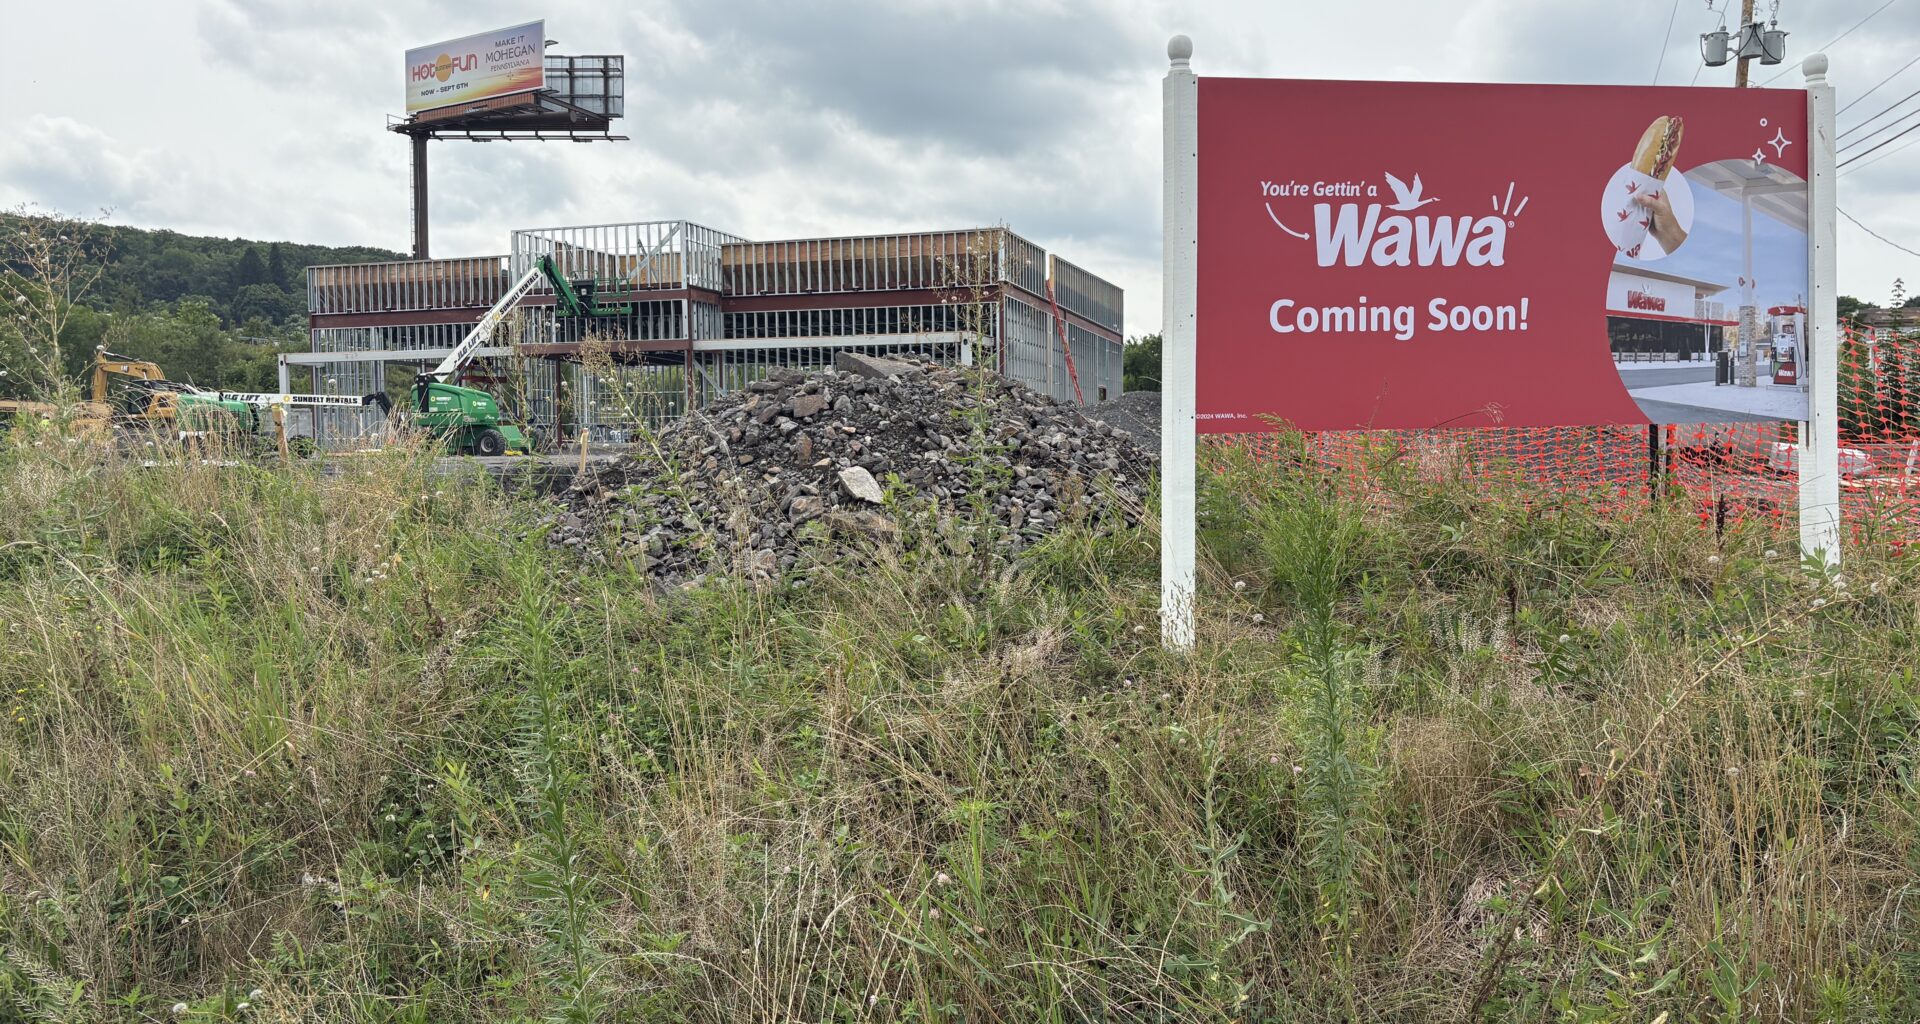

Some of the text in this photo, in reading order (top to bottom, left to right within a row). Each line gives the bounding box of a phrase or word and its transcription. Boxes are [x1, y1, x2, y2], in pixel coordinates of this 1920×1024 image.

[495, 35, 525, 48] MAKE IT
[485, 43, 536, 63] MOHEGAN
[490, 59, 530, 72] PENNSYLVANIA
[420, 89, 435, 97] NOW
[440, 85, 456, 93] SEPT
[456, 82, 469, 90] 6TH
[1261, 180, 1378, 197] You're Gettin' a
[1313, 203, 1508, 268] Wawa
[499, 272, 540, 315] SUNBELT RENTALS
[1627, 290, 1666, 312] Wawa
[1269, 296, 1530, 341] Coming Soon!
[467, 332, 481, 350] LIFT
[240, 394, 261, 402] LIFT
[292, 395, 325, 404] SUNBELT
[325, 396, 358, 405] RENTALS
